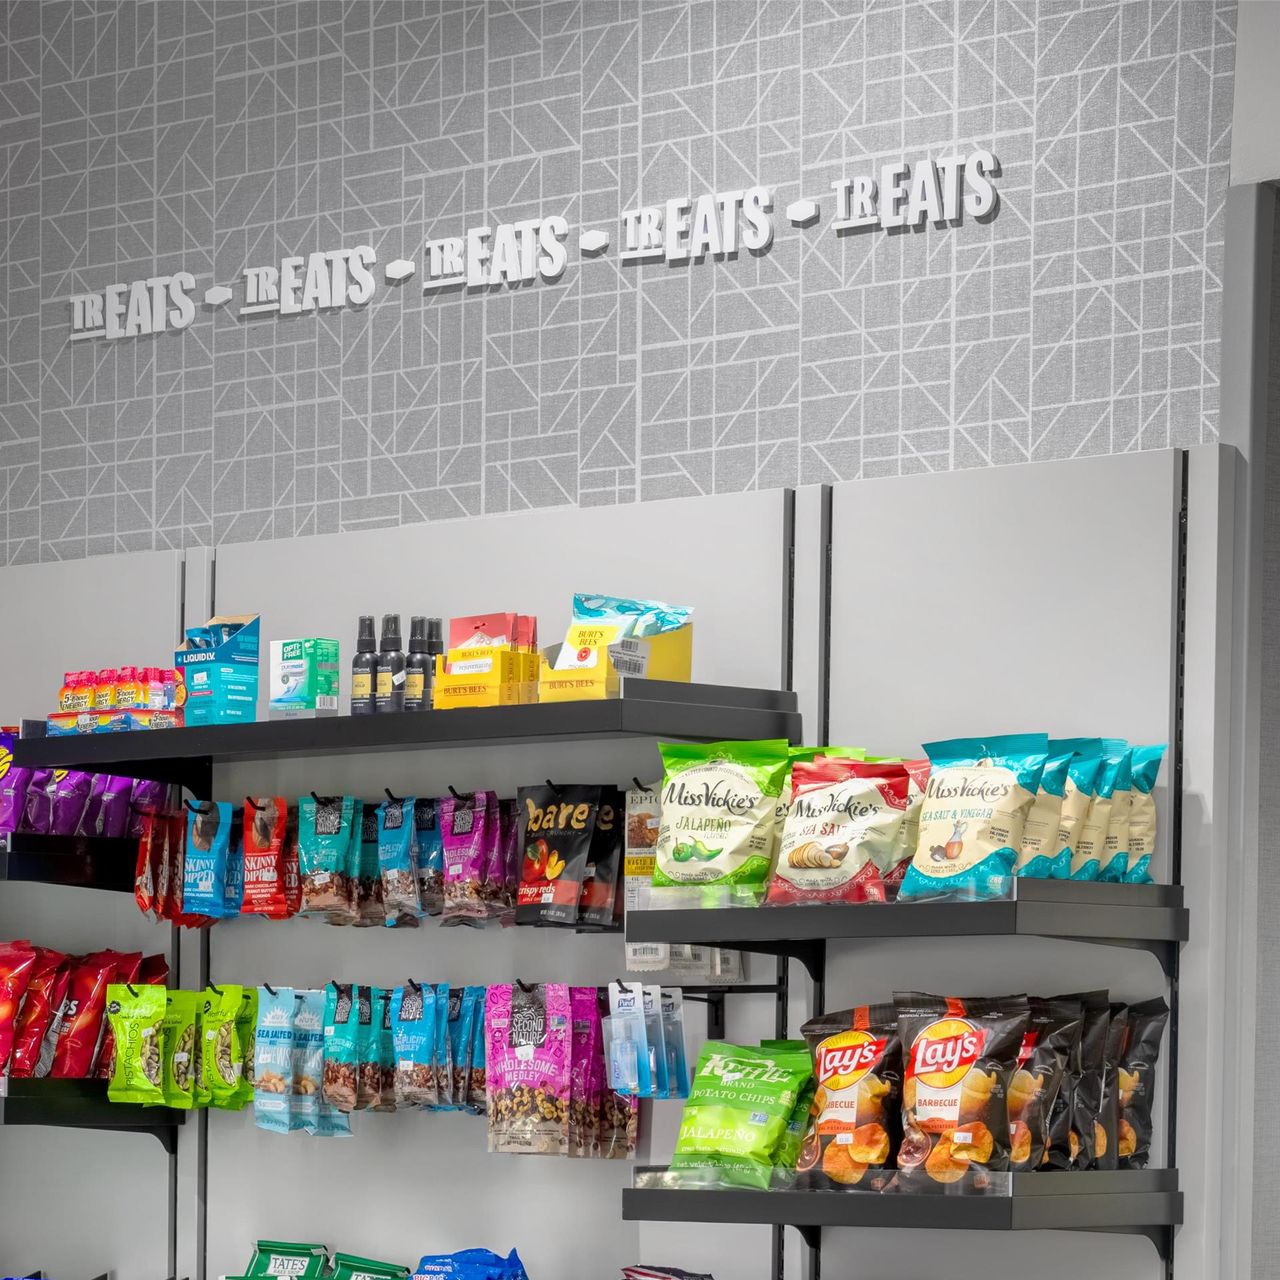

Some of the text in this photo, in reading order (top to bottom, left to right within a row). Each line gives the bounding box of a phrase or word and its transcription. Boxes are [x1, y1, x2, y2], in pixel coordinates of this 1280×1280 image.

[578, 630, 604, 638] BURT'S
[283, 642, 302, 653] OPTI-
[579, 638, 598, 646] BEES
[183, 653, 205, 664] LIQUID
[283, 650, 302, 660] FREE
[443, 684, 488, 694] BURT'S BEES
[548, 678, 595, 690] BURT'S BEES
[525, 797, 590, 832] bare
[921, 807, 994, 822] SEA SALT & VINEGAR
[800, 825, 817, 837] SEA
[184, 859, 216, 872] SKINNY
[244, 855, 278, 870] SKINNY
[518, 883, 556, 895] crispy reds
[512, 1017, 544, 1033] SECOND
[256, 1029, 292, 1040] SEA SALTED
[298, 1032, 324, 1043] SALTED
[512, 1031, 543, 1045] NATURE
[123, 1022, 140, 1087] PISTACHIOS
[914, 1032, 977, 1074] Lay's
[819, 1041, 876, 1080] Lay's
[494, 1059, 559, 1077] WHOLESOME
[505, 1070, 541, 1082] MEDLEY
[720, 1080, 755, 1090] BRAND
[692, 1087, 776, 1105] POTATO CHIPS
[917, 1098, 958, 1107] BARBECUE
[272, 1257, 307, 1271] TATE'S
